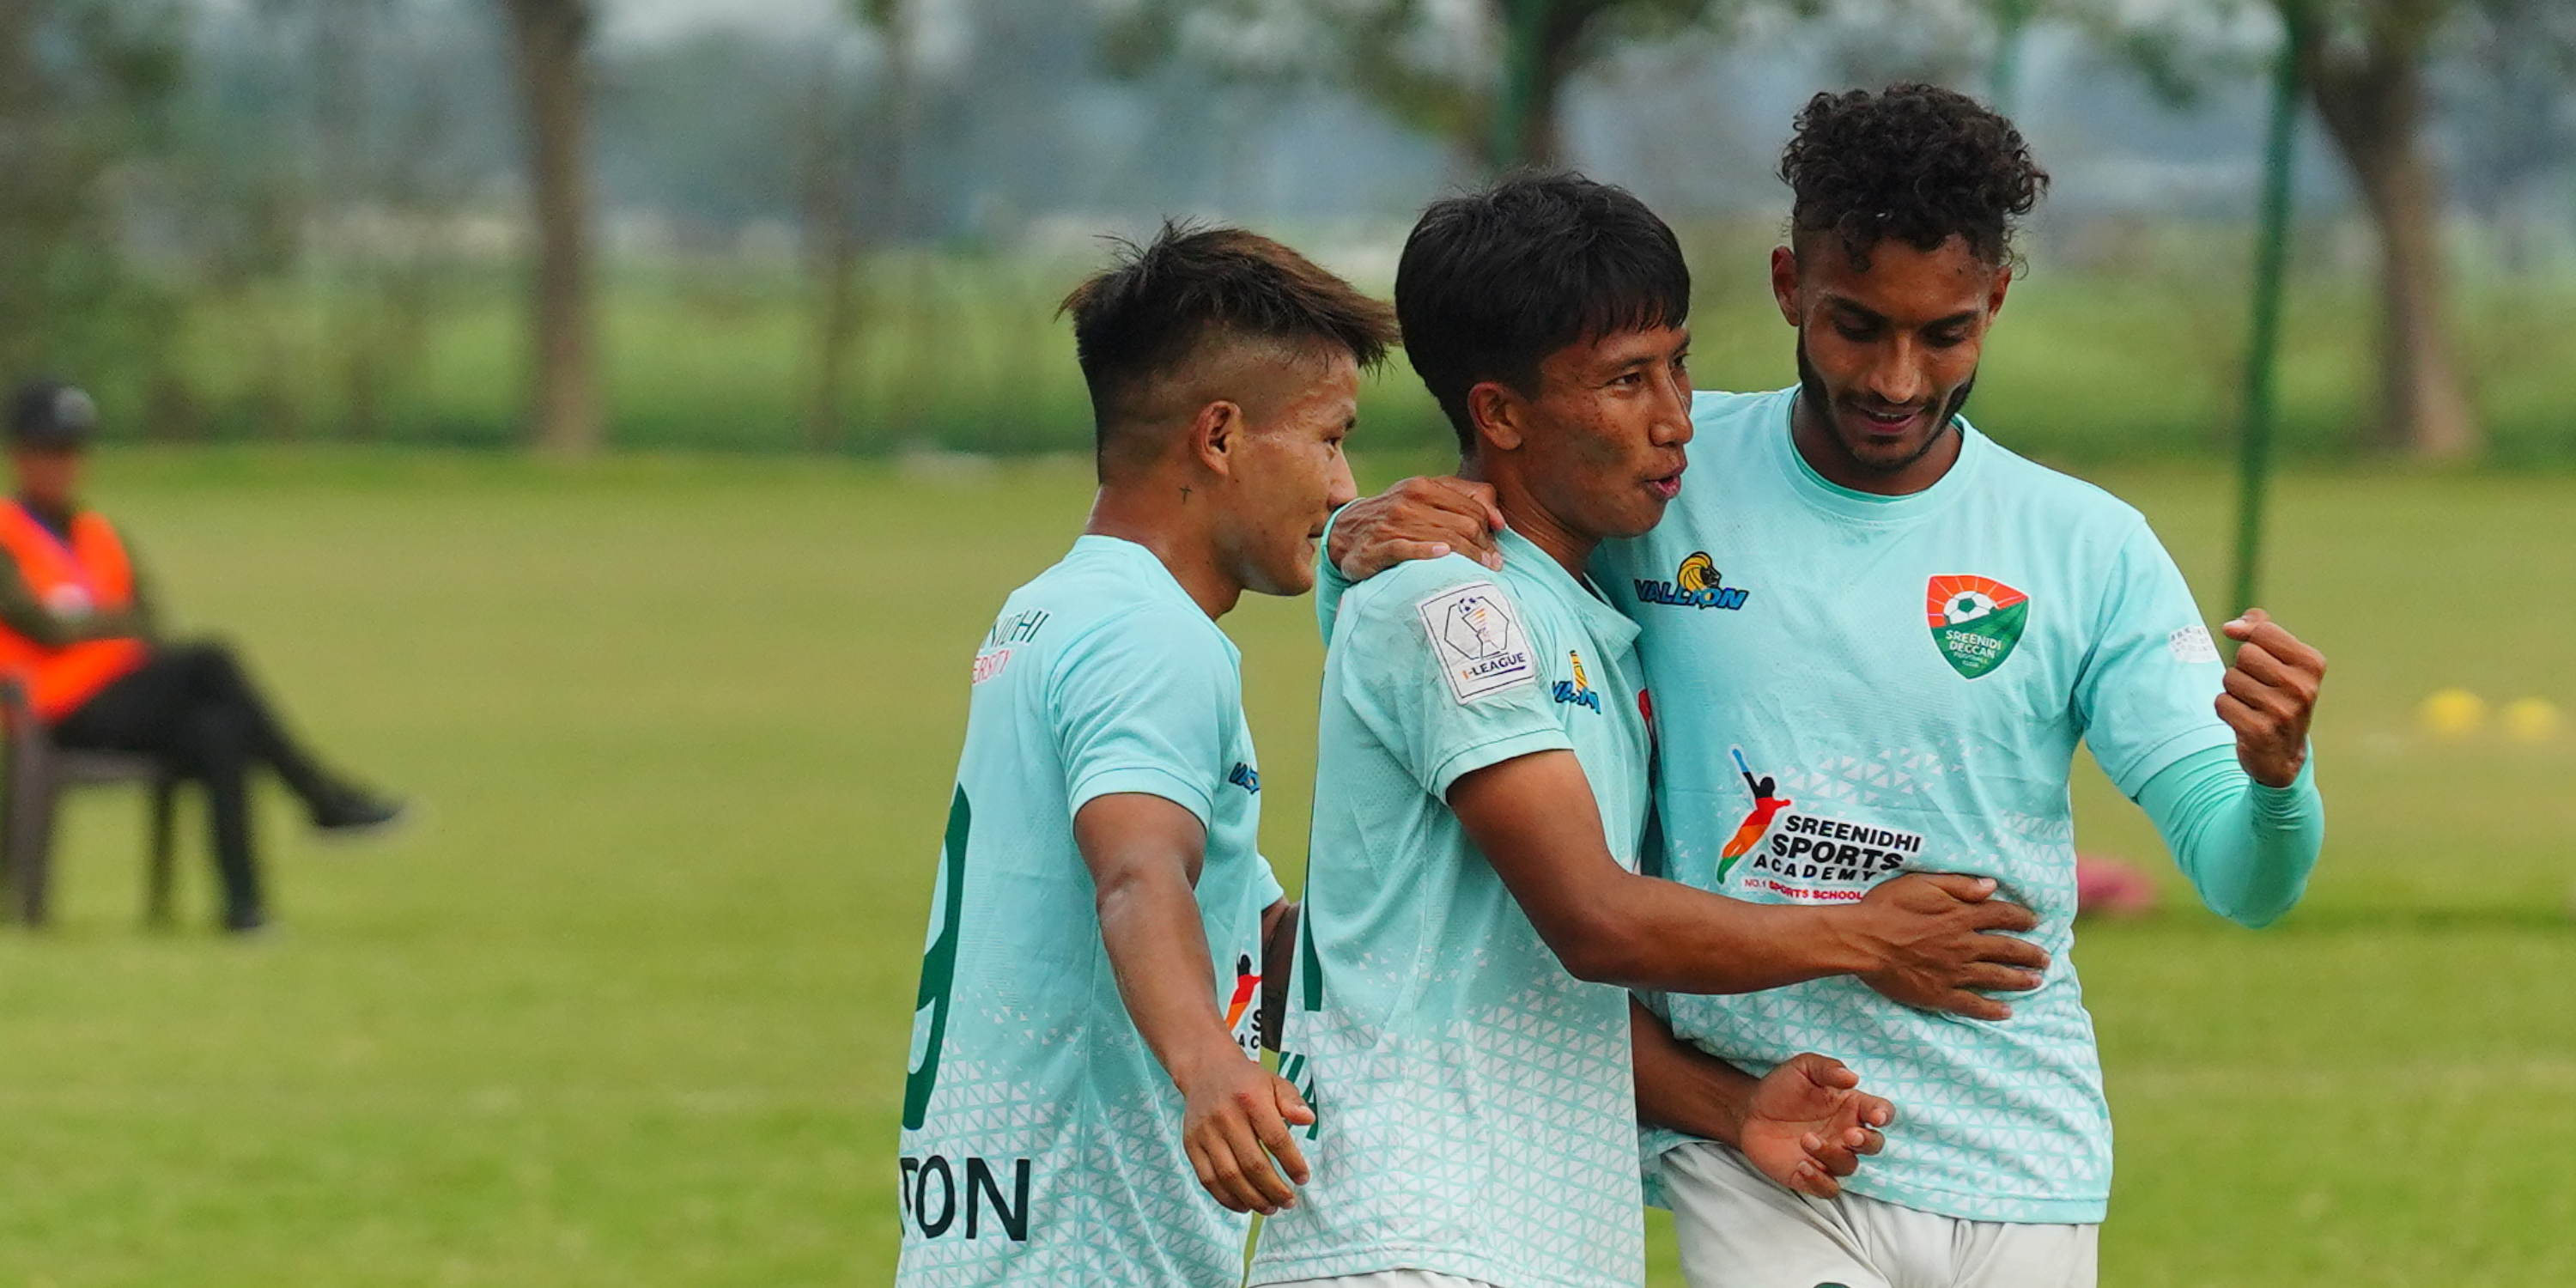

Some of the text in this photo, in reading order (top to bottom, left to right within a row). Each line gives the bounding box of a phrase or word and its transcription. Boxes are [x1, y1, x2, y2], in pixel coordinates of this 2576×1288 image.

[1633, 579, 1750, 611] VALLION
[1945, 629, 2002, 651] SREENIDI
[1949, 641, 1996, 659] DECCAN
[1462, 652, 1527, 680] I-LEAGUE
[1784, 815, 1922, 853] SREENIDHI
[1771, 833, 1904, 872] SPORTS
[1753, 854, 1877, 882] ACADEMY
[1769, 880, 1809, 899] SPORTS
[1813, 890, 1864, 901] SCHOOL
